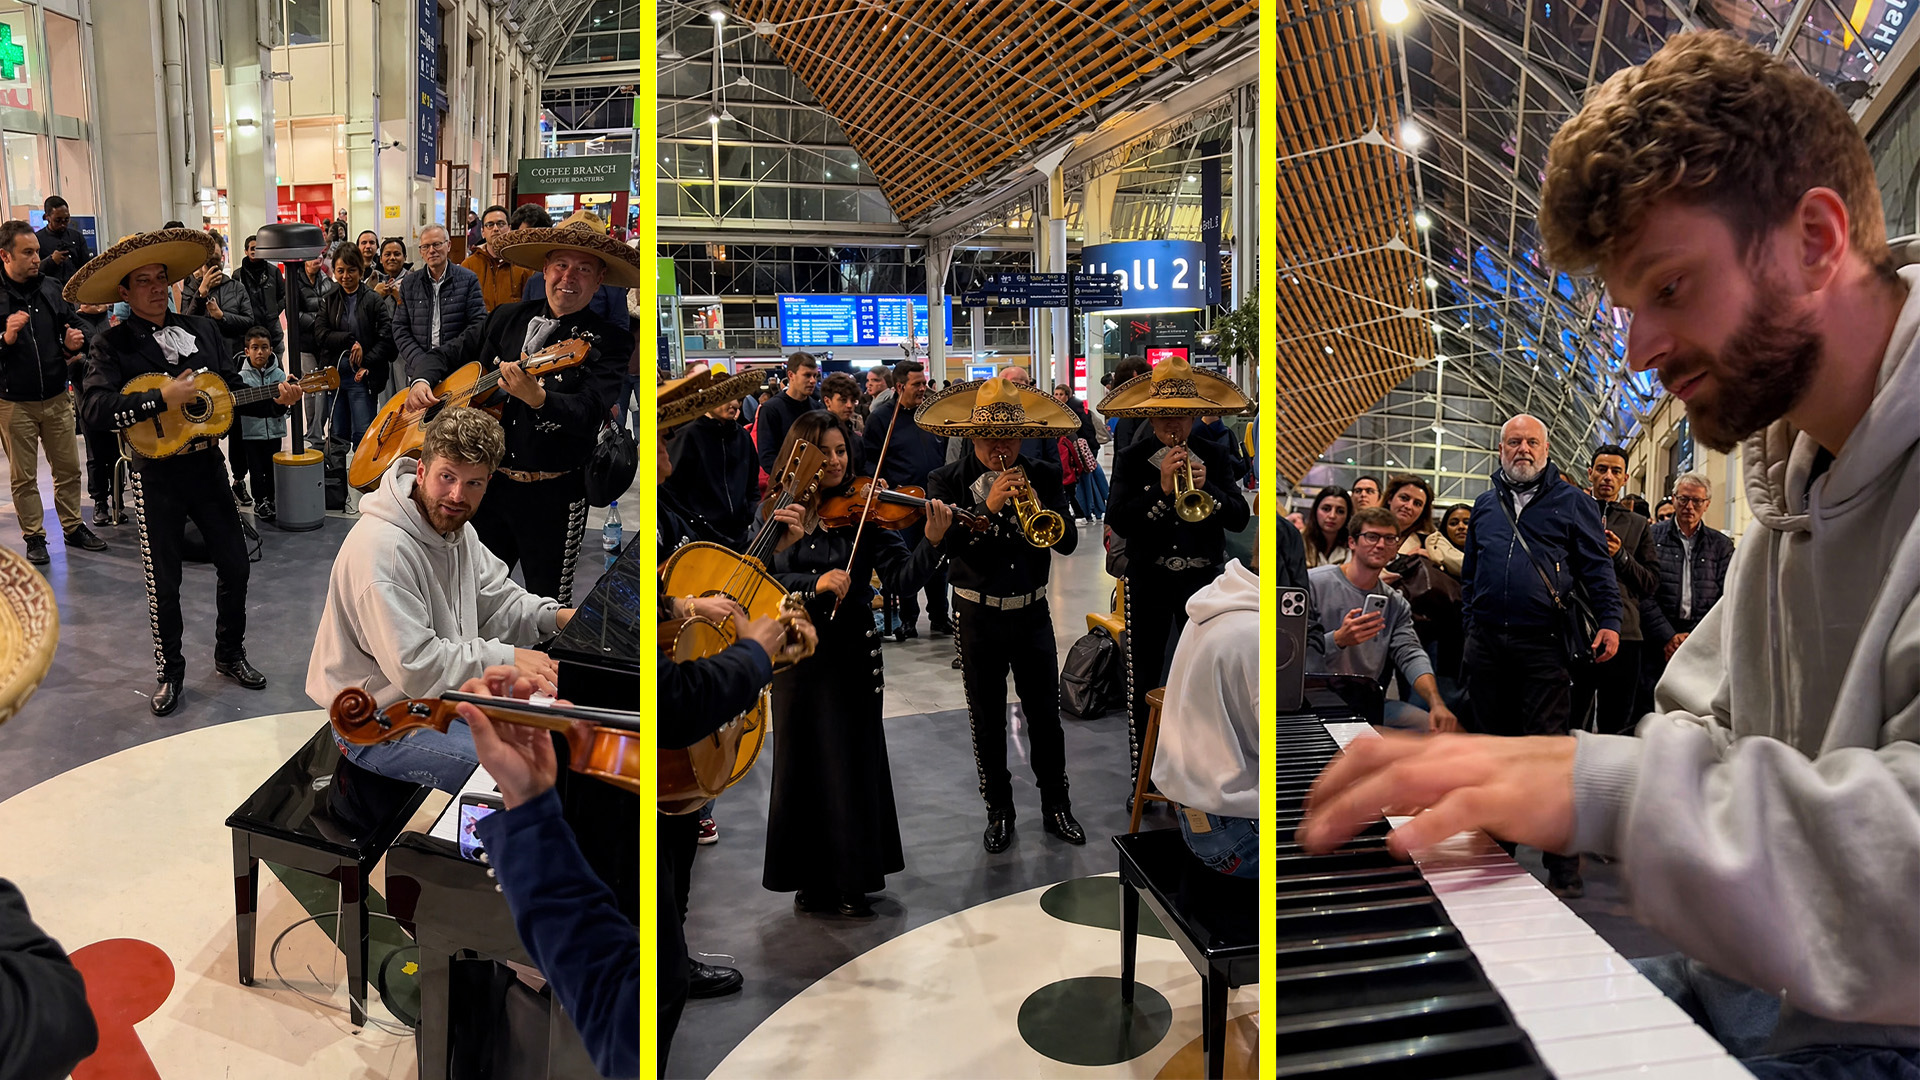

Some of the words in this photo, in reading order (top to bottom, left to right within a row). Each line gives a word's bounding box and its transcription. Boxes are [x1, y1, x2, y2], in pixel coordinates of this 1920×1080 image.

[531, 167, 571, 177] COFFEE
[573, 164, 617, 175] BRANCH
[571, 175, 605, 183] ROASTERS
[1172, 257, 1189, 290] 2
